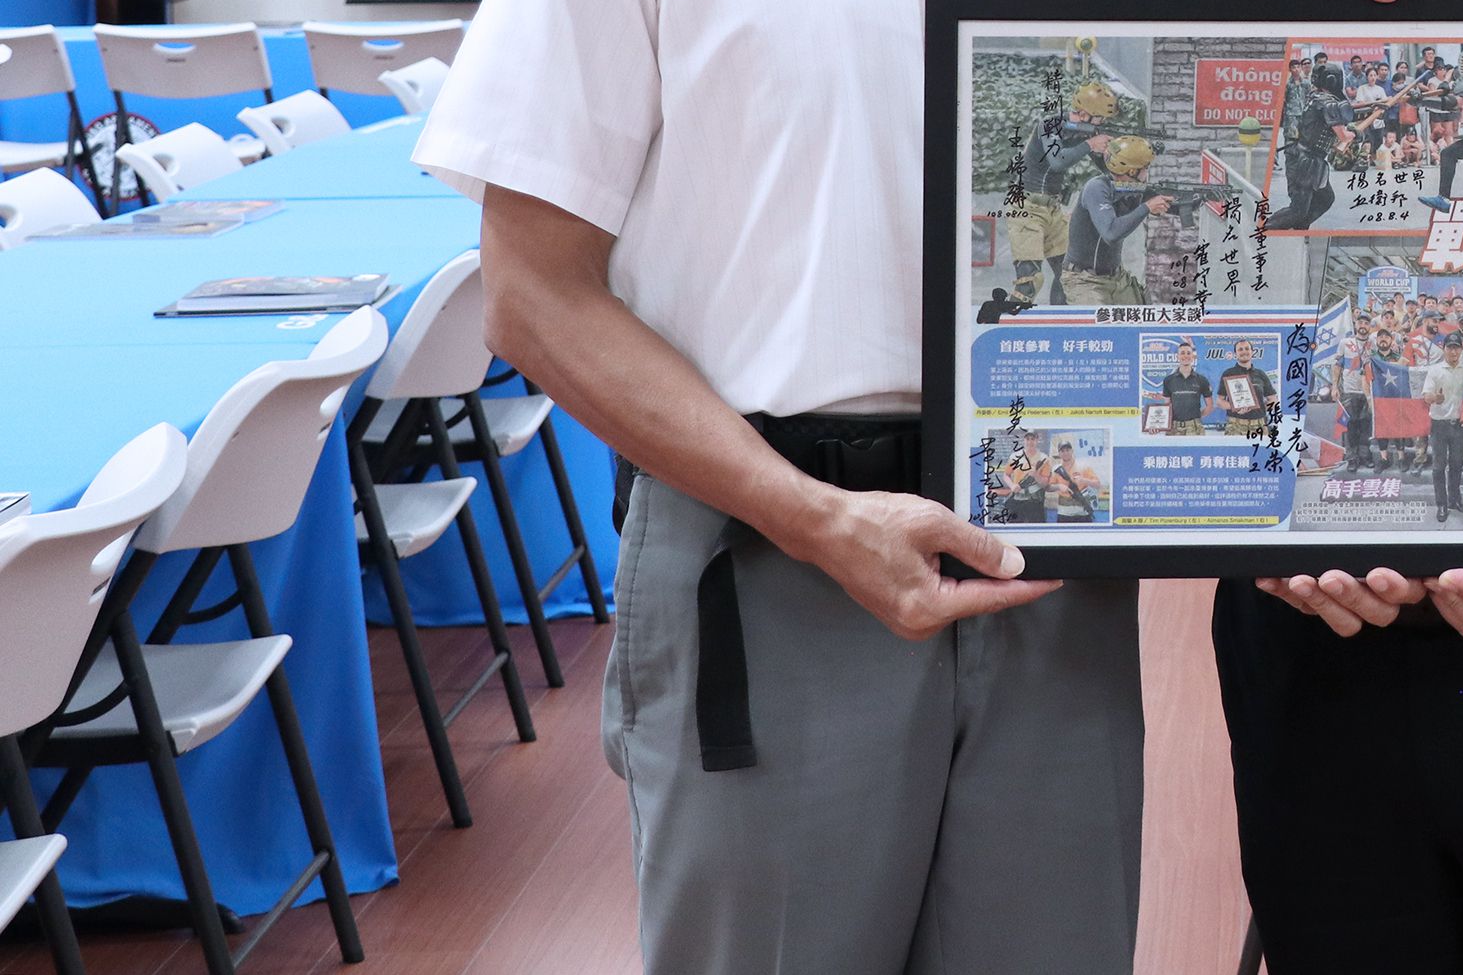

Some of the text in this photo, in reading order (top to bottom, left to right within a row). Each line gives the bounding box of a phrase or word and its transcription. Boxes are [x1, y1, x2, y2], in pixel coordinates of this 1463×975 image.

[1215, 67, 1281, 86] Không
[1220, 86, 1273, 105] đóng
[1203, 108, 1221, 120] DO
[1225, 109, 1251, 120] NOT
[1367, 278, 1410, 286] WORLD CUP
[1096, 307, 1202, 323] 參賽隊伍大家談
[1000, 339, 1114, 353] 首度參賽 好手較勁
[1205, 348, 1225, 360] JUL
[1143, 455, 1251, 470] 乘勝追擊 勇奪佳績
[1321, 477, 1402, 500] 高手雲集
